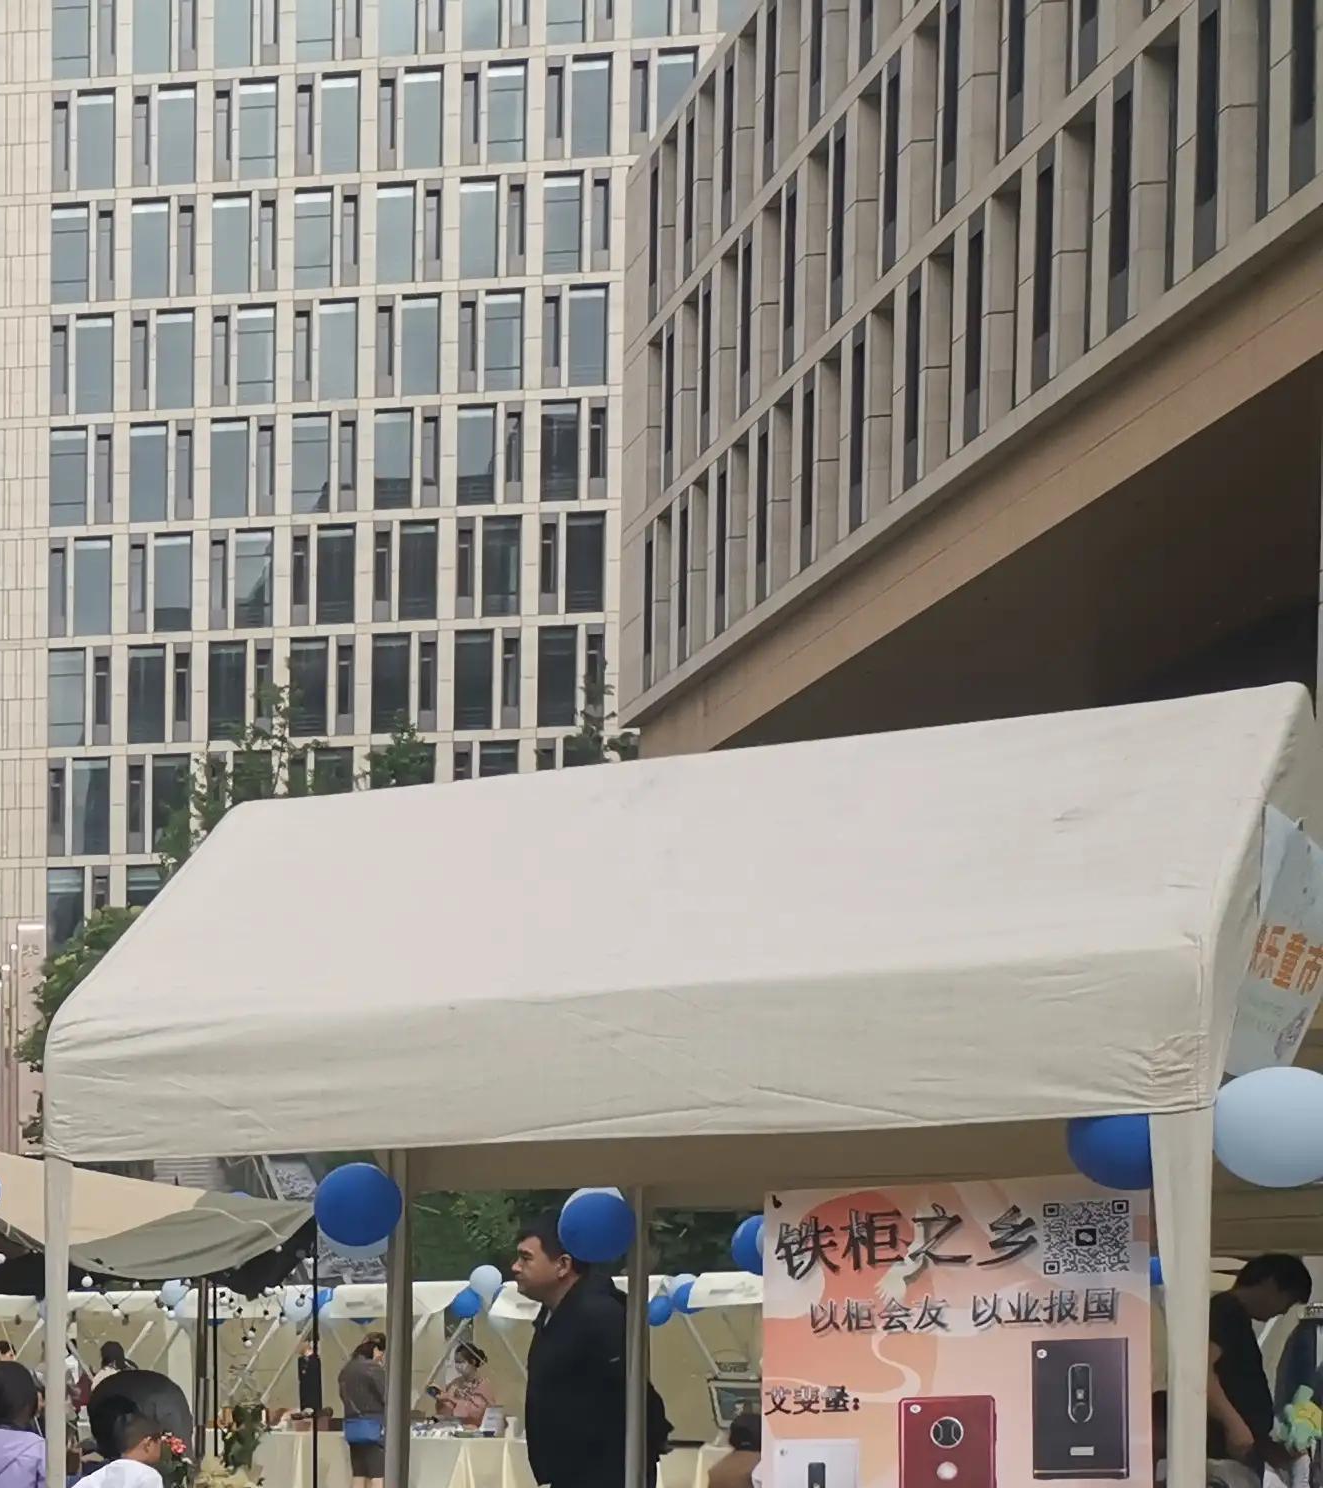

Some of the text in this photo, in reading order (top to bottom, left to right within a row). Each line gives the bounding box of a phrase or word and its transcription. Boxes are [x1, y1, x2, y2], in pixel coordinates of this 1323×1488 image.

[774, 1202, 1040, 1281] 铁柜之乡
[809, 1287, 1120, 1335] 以柜会友 以业报国
